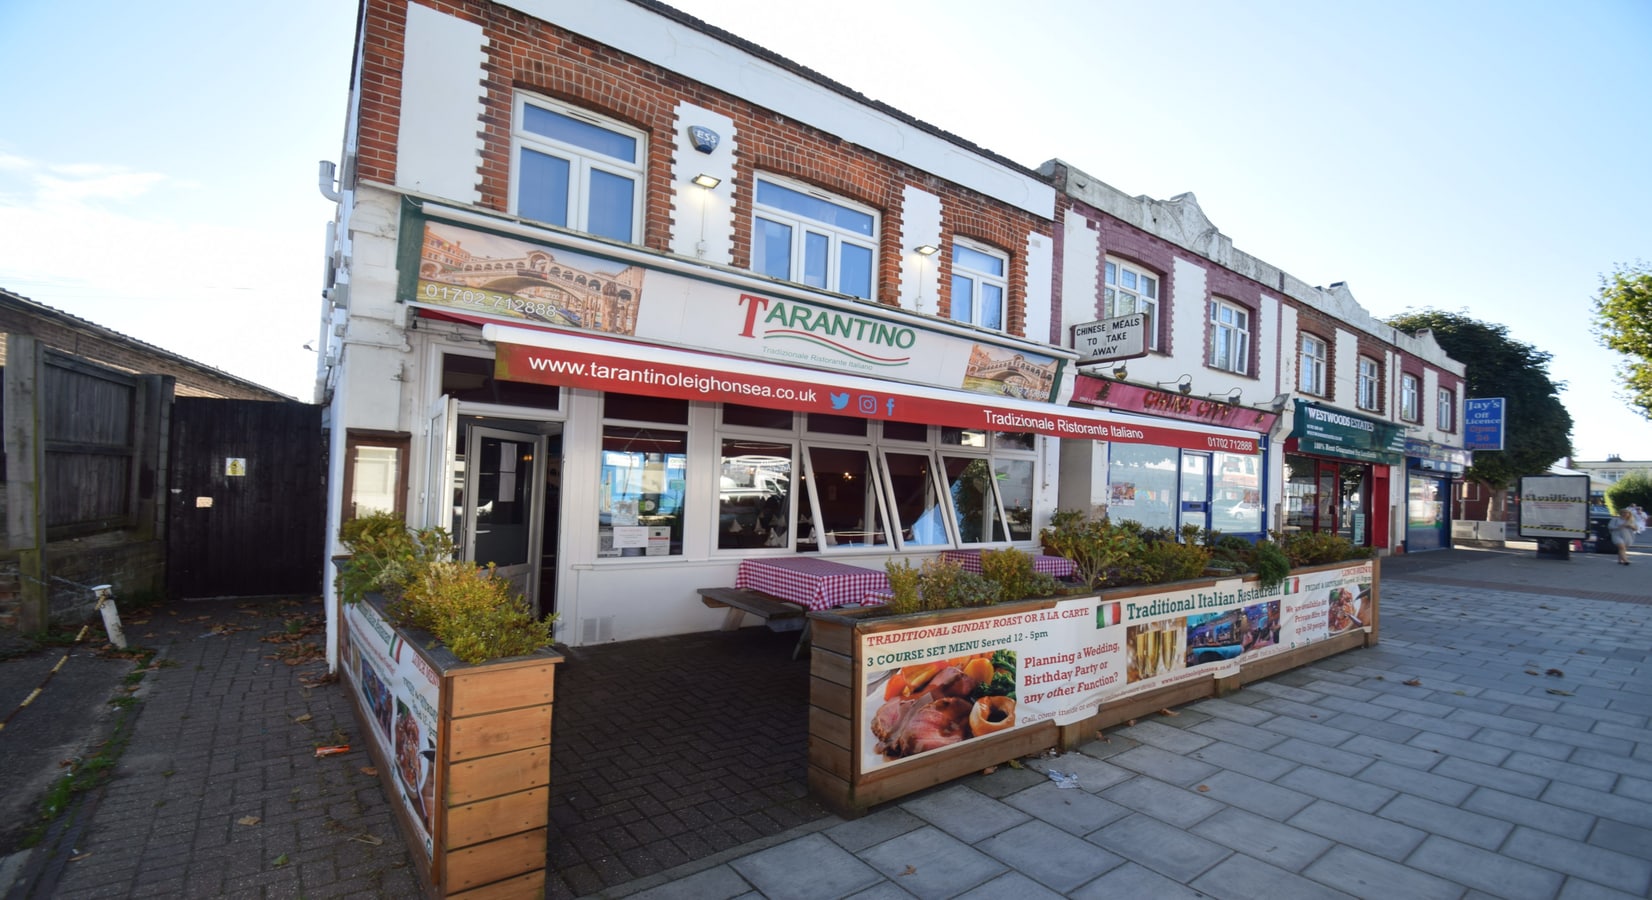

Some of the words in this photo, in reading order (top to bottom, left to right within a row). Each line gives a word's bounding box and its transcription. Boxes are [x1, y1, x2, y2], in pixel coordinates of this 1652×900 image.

[697, 130, 717, 144] ESS
[425, 283, 486, 306] 01702
[493, 290, 557, 318] 712888
[738, 294, 916, 350] TARANTINO
[1076, 324, 1106, 337] CHINESE
[1112, 317, 1140, 330] MEALS
[1087, 336, 1098, 346] TO
[1106, 332, 1127, 342] TAKE
[1092, 345, 1118, 356] AWAY
[763, 346, 808, 360] Tradizionale
[811, 354, 848, 366] Ristorante
[848, 361, 873, 370] Italiano
[527, 355, 817, 403] www.tarantinoleighonsea.co.uk
[1143, 391, 1192, 414] CHINA
[1197, 401, 1231, 420] CITY
[1468, 400, 1500, 410] Jay's
[984, 410, 1054, 430] Tradizionale
[1057, 419, 1108, 436] Ristorante
[1110, 425, 1144, 440] Italiano
[1308, 407, 1351, 427] WESTWOODS
[1350, 419, 1374, 432] ESTATES
[1207, 436, 1228, 448] 01702
[1229, 438, 1252, 451] 712888
[1126, 594, 1196, 620] Traditional
[1198, 587, 1236, 607] Italian
[1238, 584, 1281, 604] Restaurant
[867, 626, 950, 647] TRADITIONAL
[952, 620, 992, 634] SUNDAY
[993, 615, 1024, 628] ROAST
[1024, 614, 1038, 624] OR
[1040, 612, 1046, 622] A
[1047, 610, 1060, 620] LA
[1062, 608, 1090, 619] CARTE
[867, 656, 874, 667] 3
[876, 649, 925, 666] COURSE
[926, 644, 947, 658] SET
[948, 640, 980, 654] MENU
[981, 635, 1012, 648] Served
[1014, 632, 1024, 642] 12
[1030, 630, 1048, 642] 5pm
[1024, 652, 1076, 669] Planning
[1077, 651, 1082, 660] a
[1082, 642, 1120, 660] Wedding,
[1024, 670, 1074, 687] Birthday
[1075, 663, 1100, 678] Party
[1100, 660, 1108, 670] or
[1024, 690, 1044, 704] any
[1046, 686, 1076, 700] other
[1077, 672, 1119, 694] Function?
